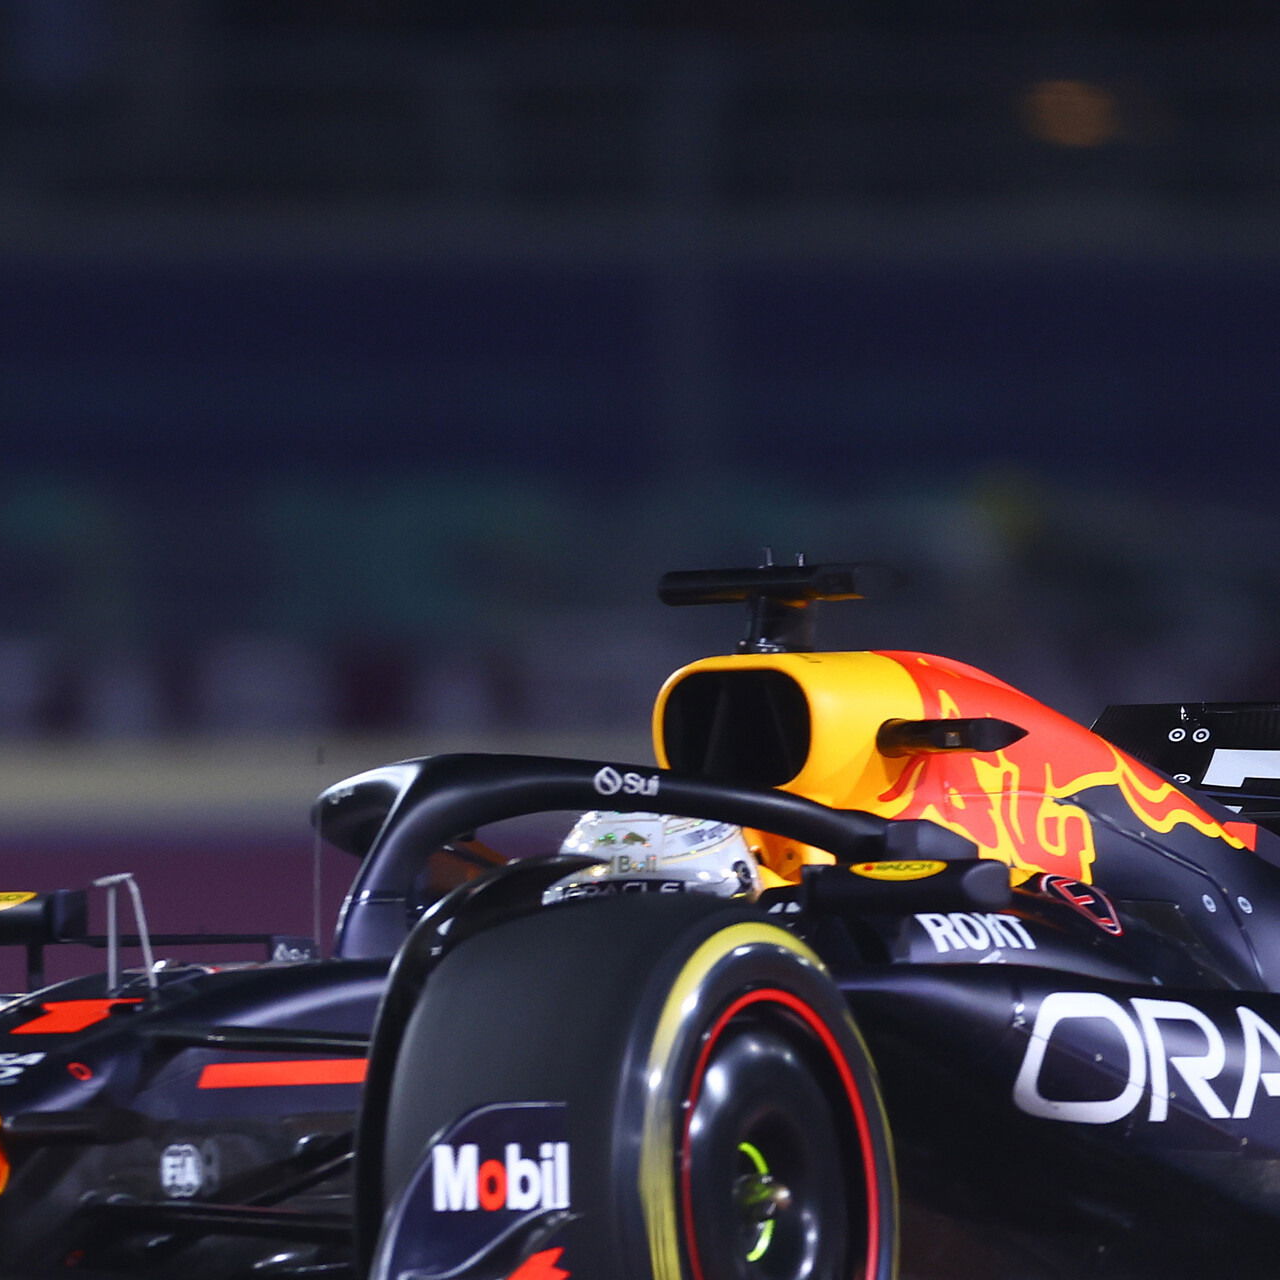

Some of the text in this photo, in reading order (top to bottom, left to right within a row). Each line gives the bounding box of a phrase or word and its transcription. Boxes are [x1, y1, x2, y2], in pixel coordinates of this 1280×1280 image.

[622, 772, 660, 796] Sui
[914, 911, 1037, 953] ROKT
[432, 1142, 570, 1211] Mobil
